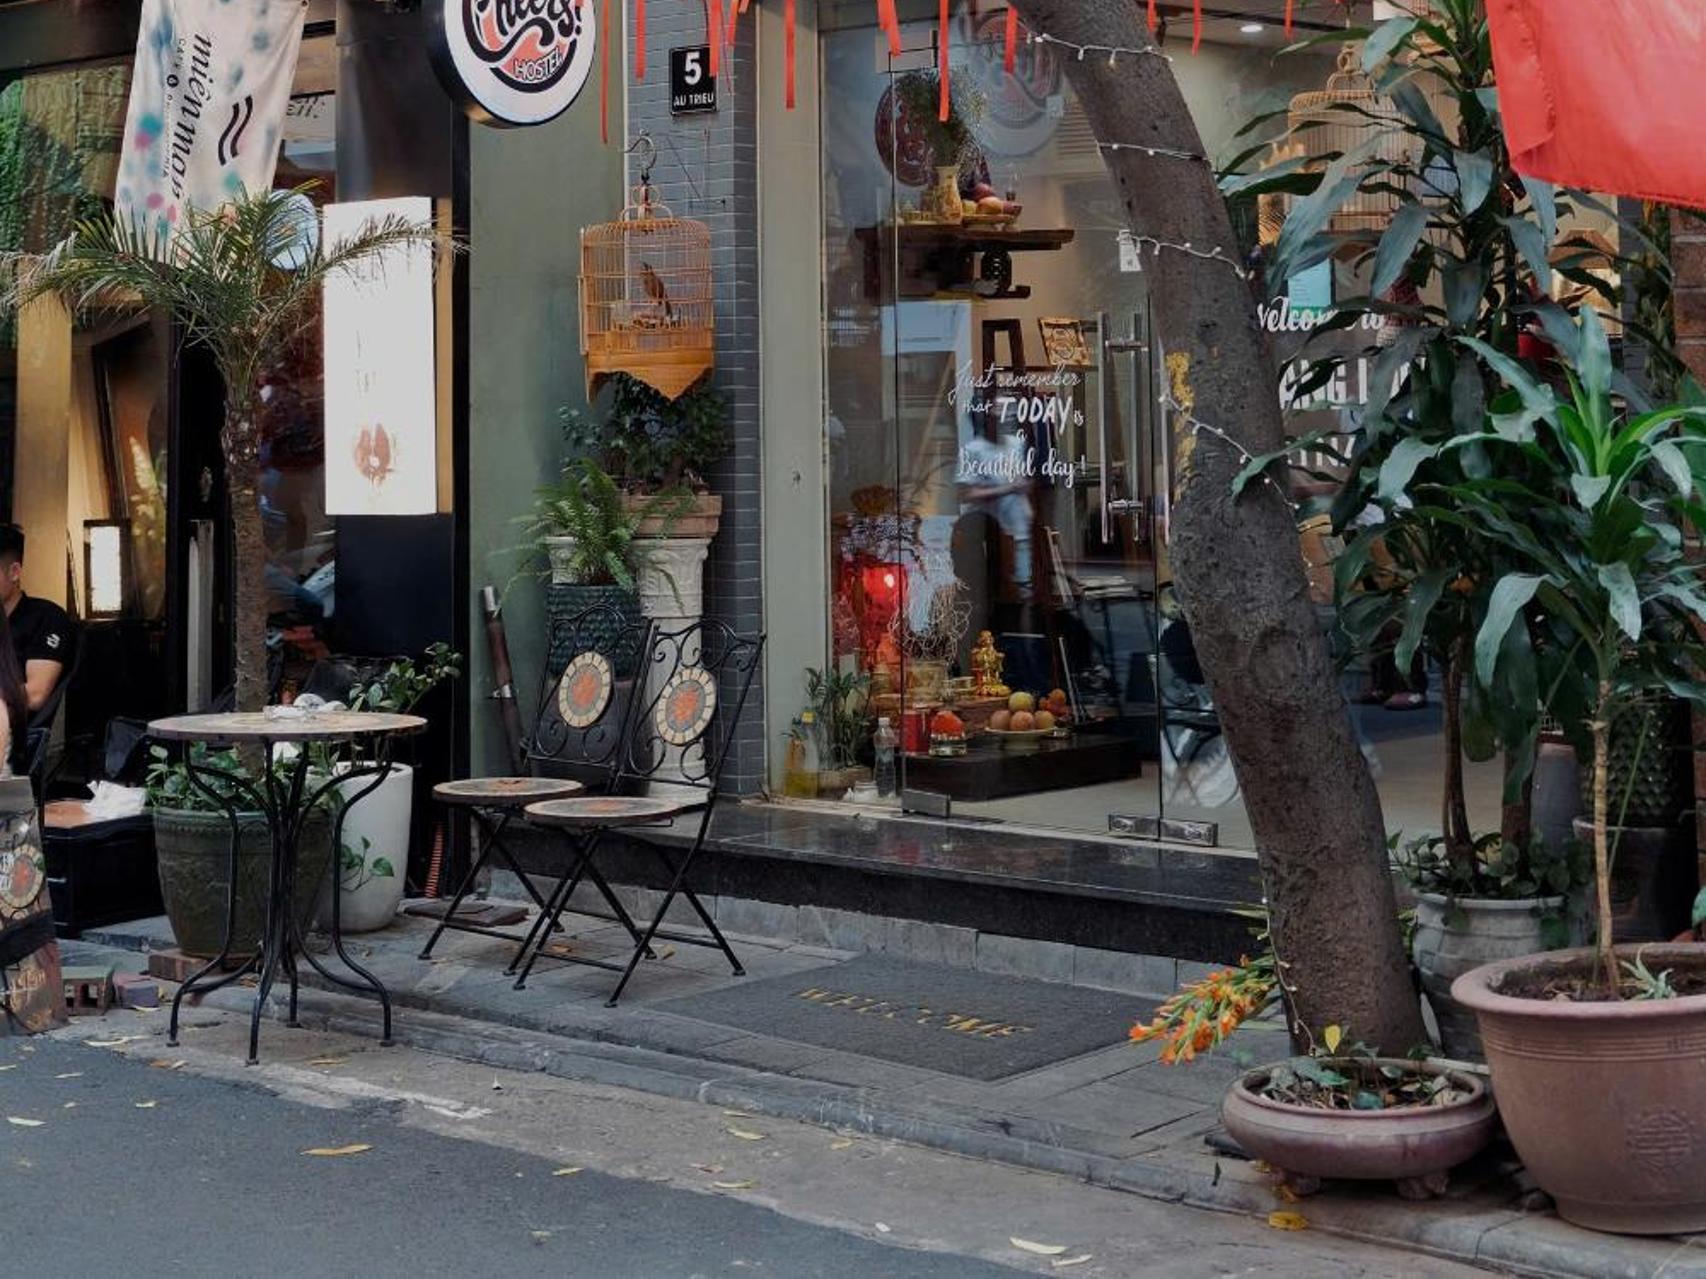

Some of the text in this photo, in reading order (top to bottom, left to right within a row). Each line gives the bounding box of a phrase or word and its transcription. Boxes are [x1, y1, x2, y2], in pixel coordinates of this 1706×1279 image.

[513, 45, 565, 81] HOSTEL
[685, 51, 702, 86] 5
[999, 361, 1081, 388] remember
[996, 395, 1073, 435] TODAY
